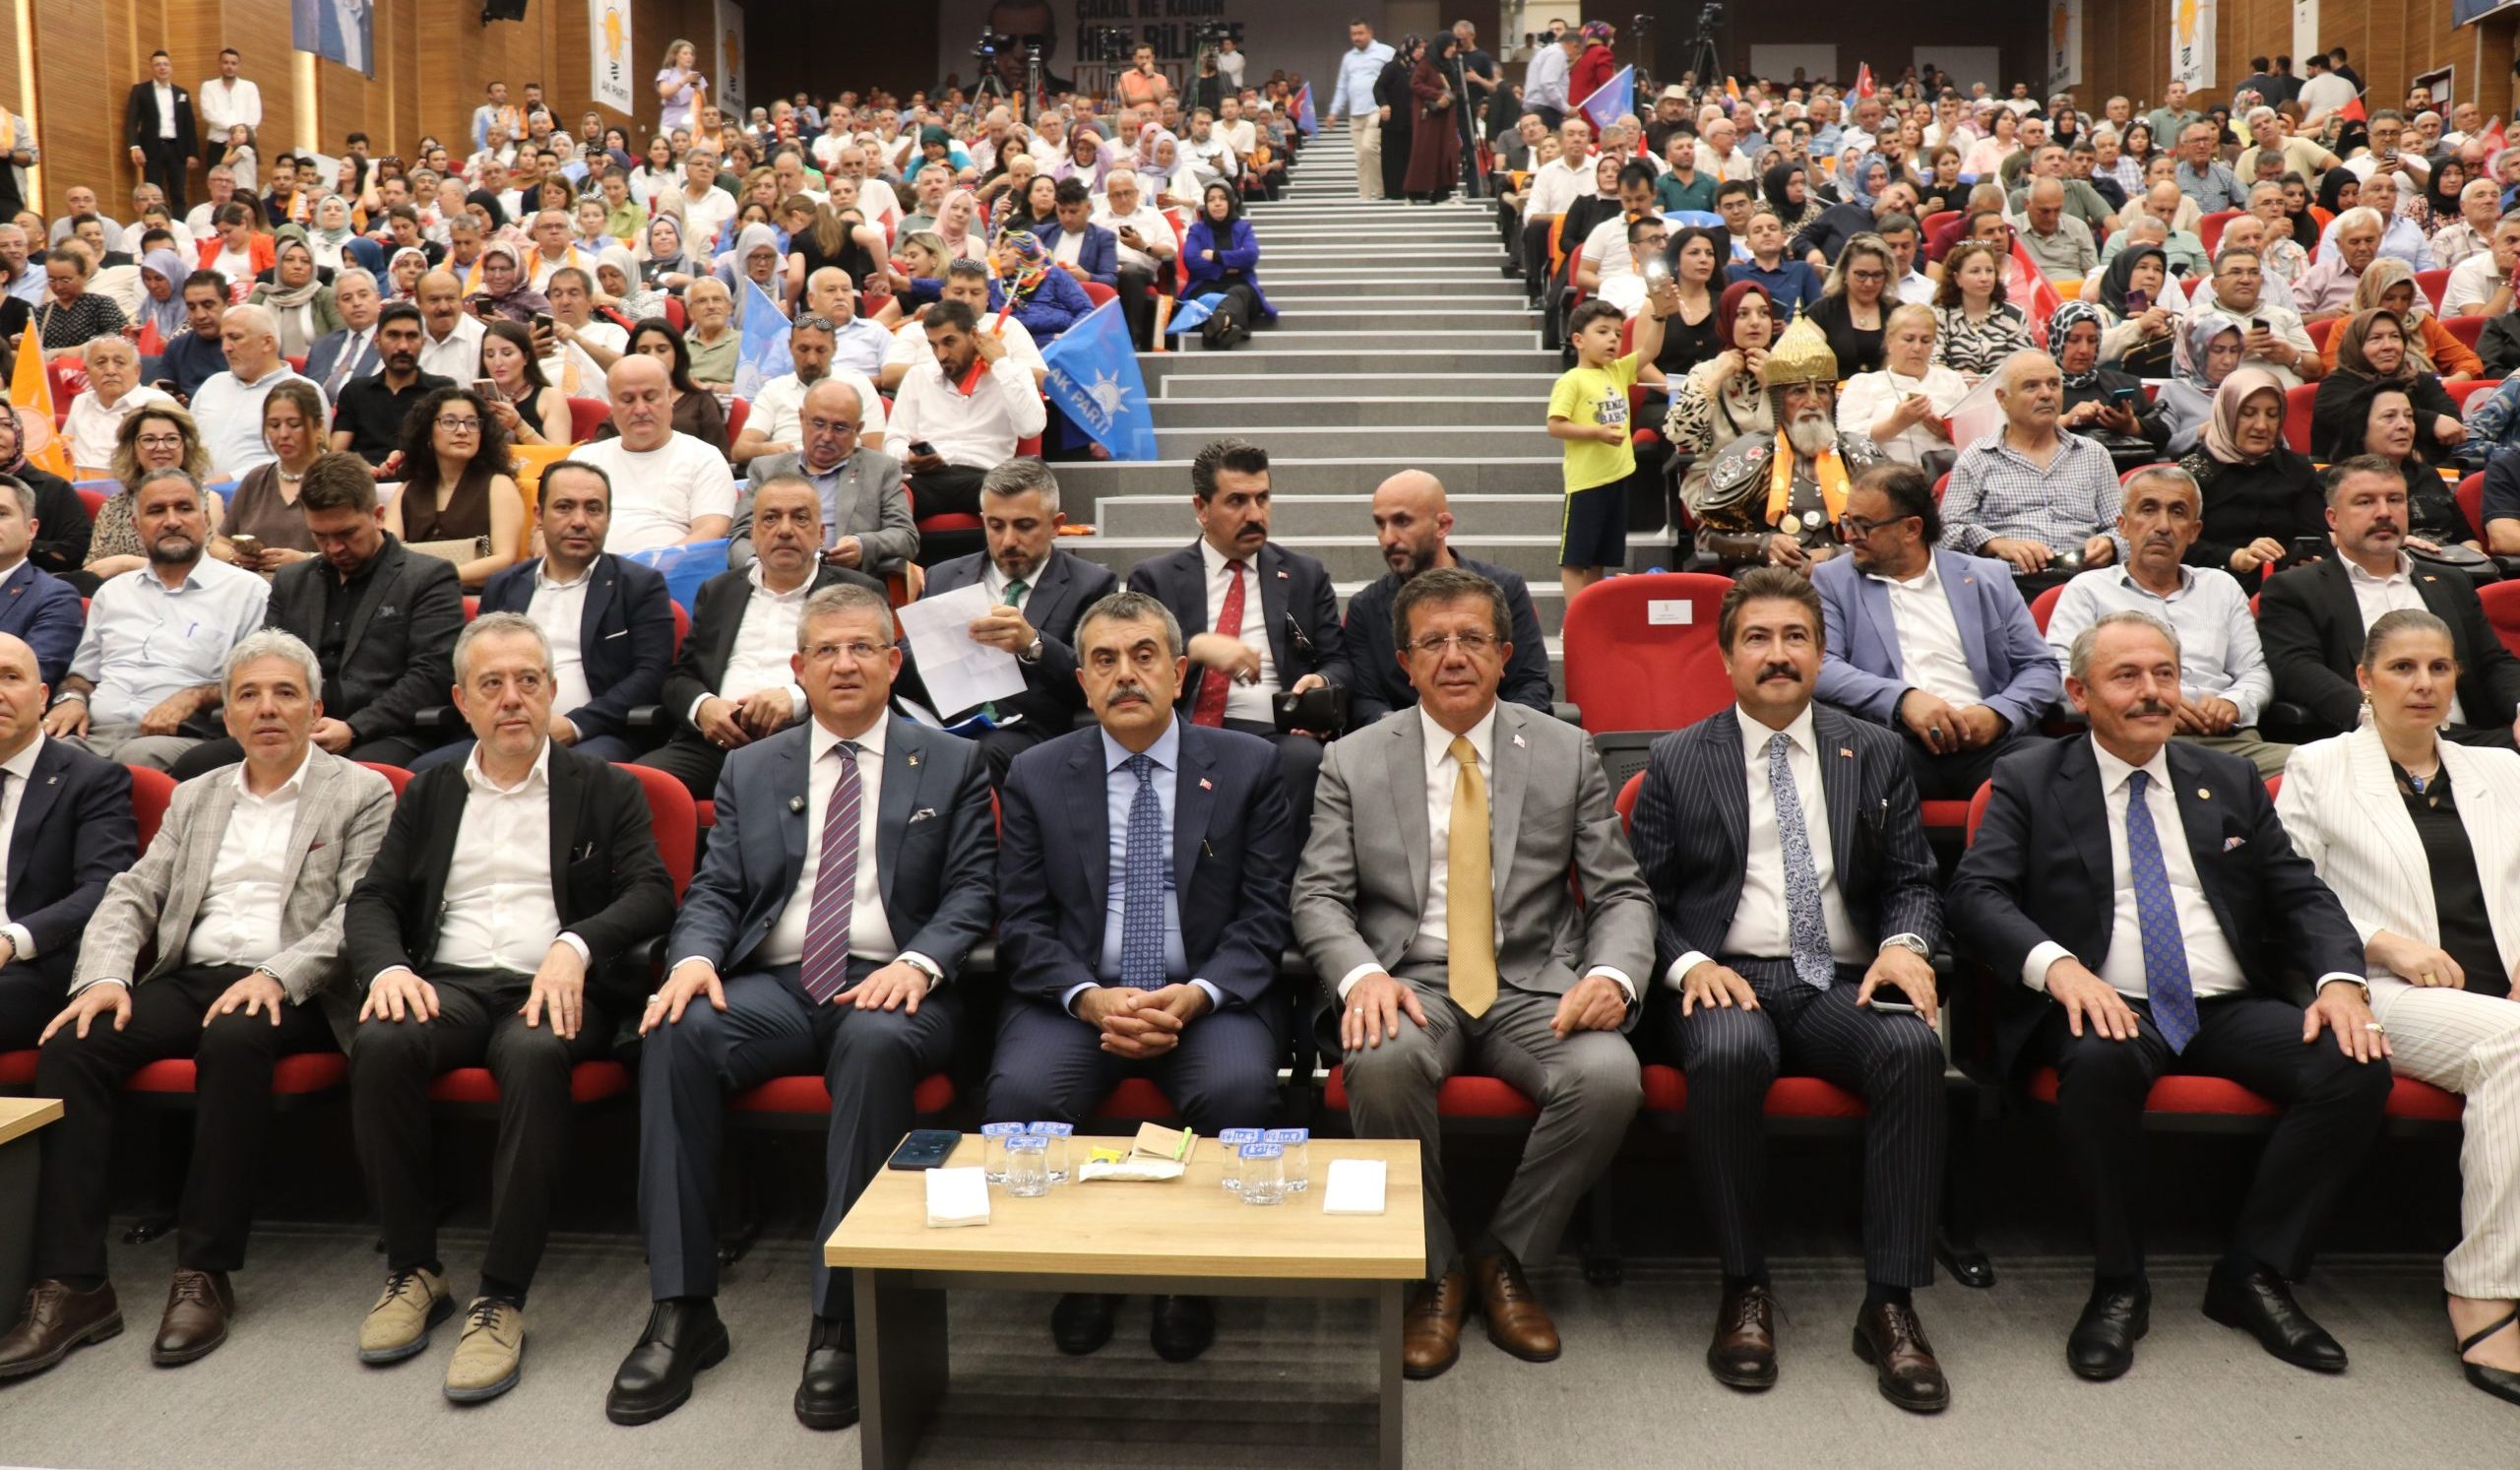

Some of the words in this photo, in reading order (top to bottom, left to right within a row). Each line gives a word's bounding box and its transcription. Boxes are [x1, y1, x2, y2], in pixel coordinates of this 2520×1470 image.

[1139, 0, 1160, 17] NE
[1077, 22, 1134, 61] HİE
[1047, 368, 1073, 393] AK
